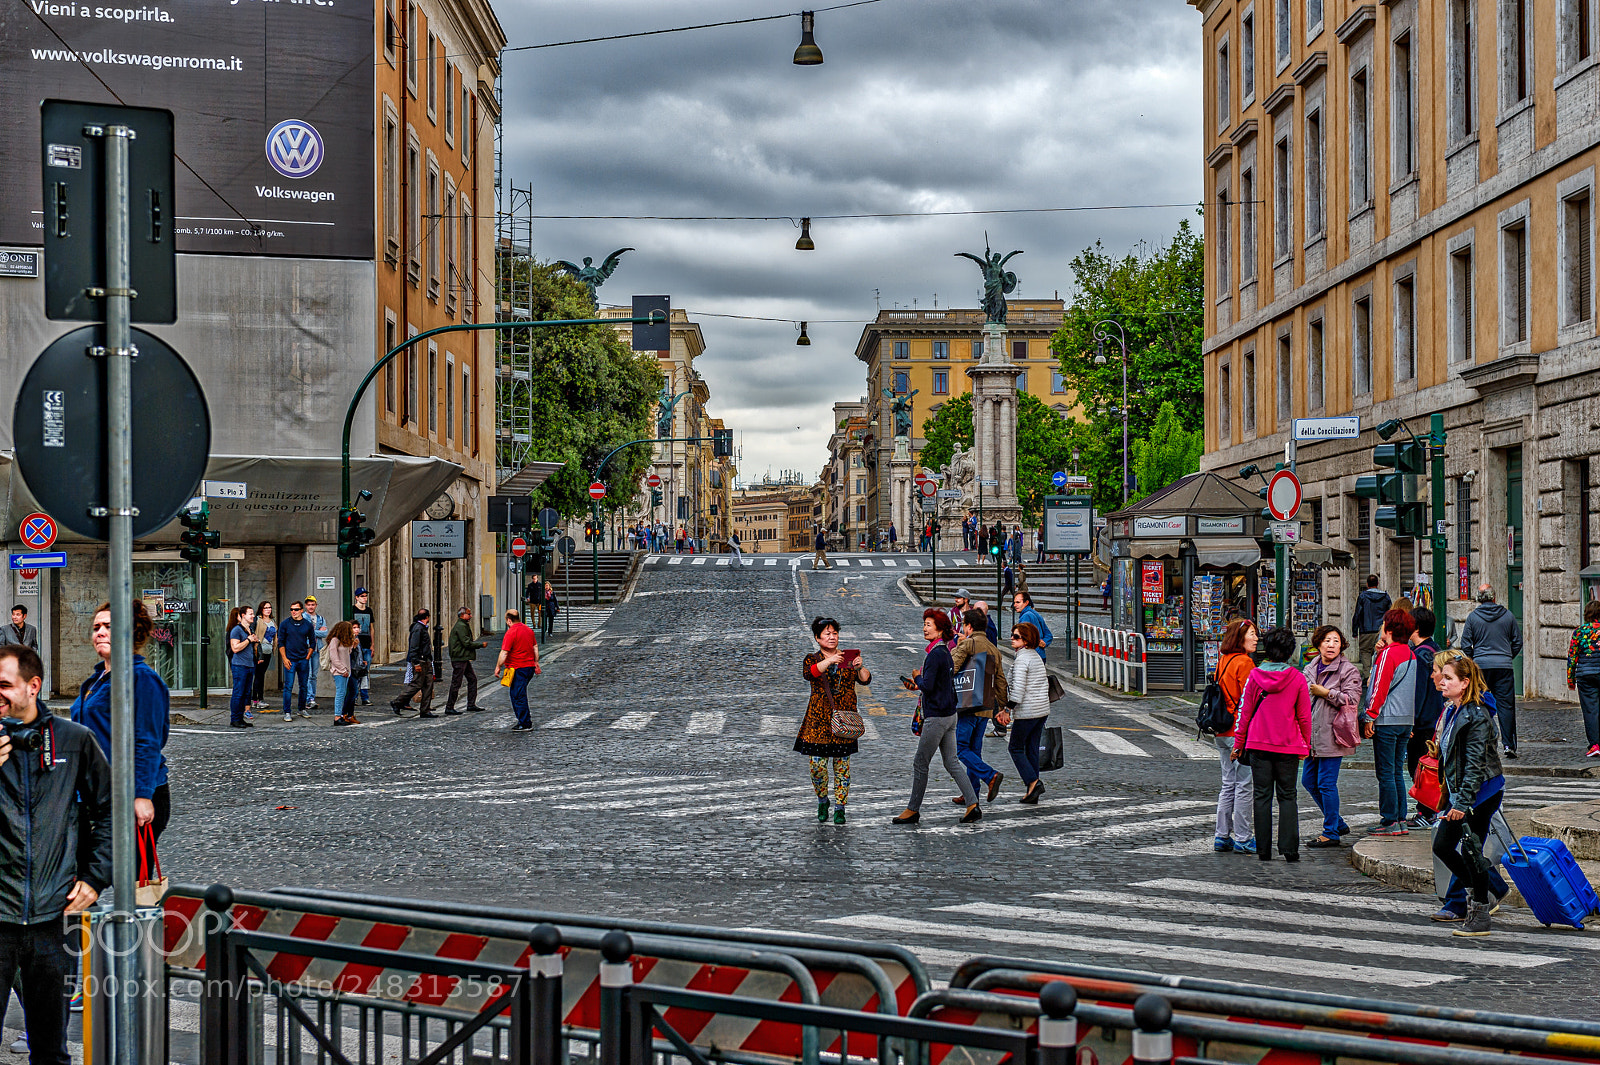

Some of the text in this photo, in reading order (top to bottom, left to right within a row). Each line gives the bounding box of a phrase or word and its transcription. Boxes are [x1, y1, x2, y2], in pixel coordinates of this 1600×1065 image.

[31, 0, 175, 23] Vieni a scoprirla.
[31, 48, 243, 71] www.volkswagenroma.it
[255, 185, 335, 203] Volkswagen
[194, 228, 204, 236] 5,7
[10, 254, 33, 263] ONE
[1301, 426, 1356, 436] della Conciliazione
[249, 490, 321, 501] finalizzate
[226, 502, 239, 510] di
[244, 503, 288, 512] questo
[1137, 521, 1168, 529] RIGAMONTI
